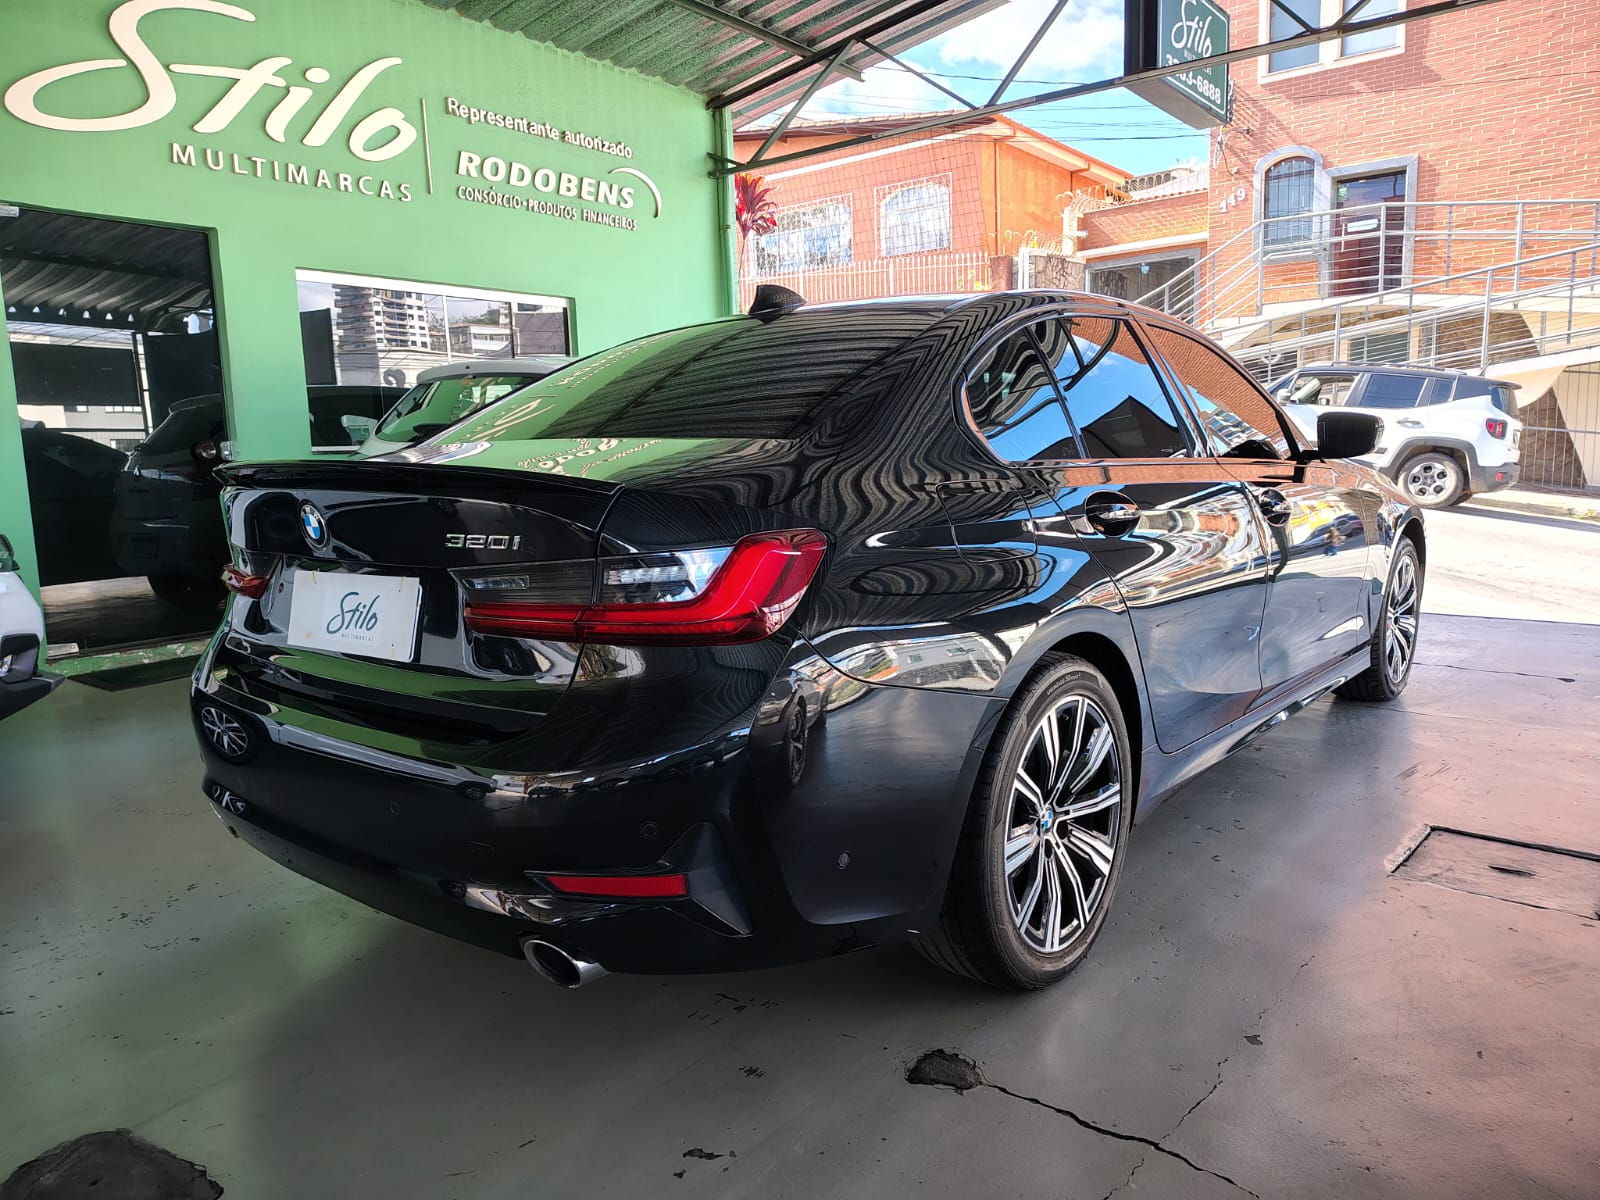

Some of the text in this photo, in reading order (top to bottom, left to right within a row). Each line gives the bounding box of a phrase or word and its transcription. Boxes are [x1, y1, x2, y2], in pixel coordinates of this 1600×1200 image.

[1171, 0, 1212, 58] Stilo
[4, 0, 418, 161] Stilo
[446, 97, 633, 159] Representante autorizado
[170, 142, 412, 202] MULTIMARCAS
[457, 151, 634, 209] RODOBENS
[581, 208, 638, 231] FINANCEIROS
[445, 534, 520, 550] 320i
[326, 591, 381, 635] Stilo
